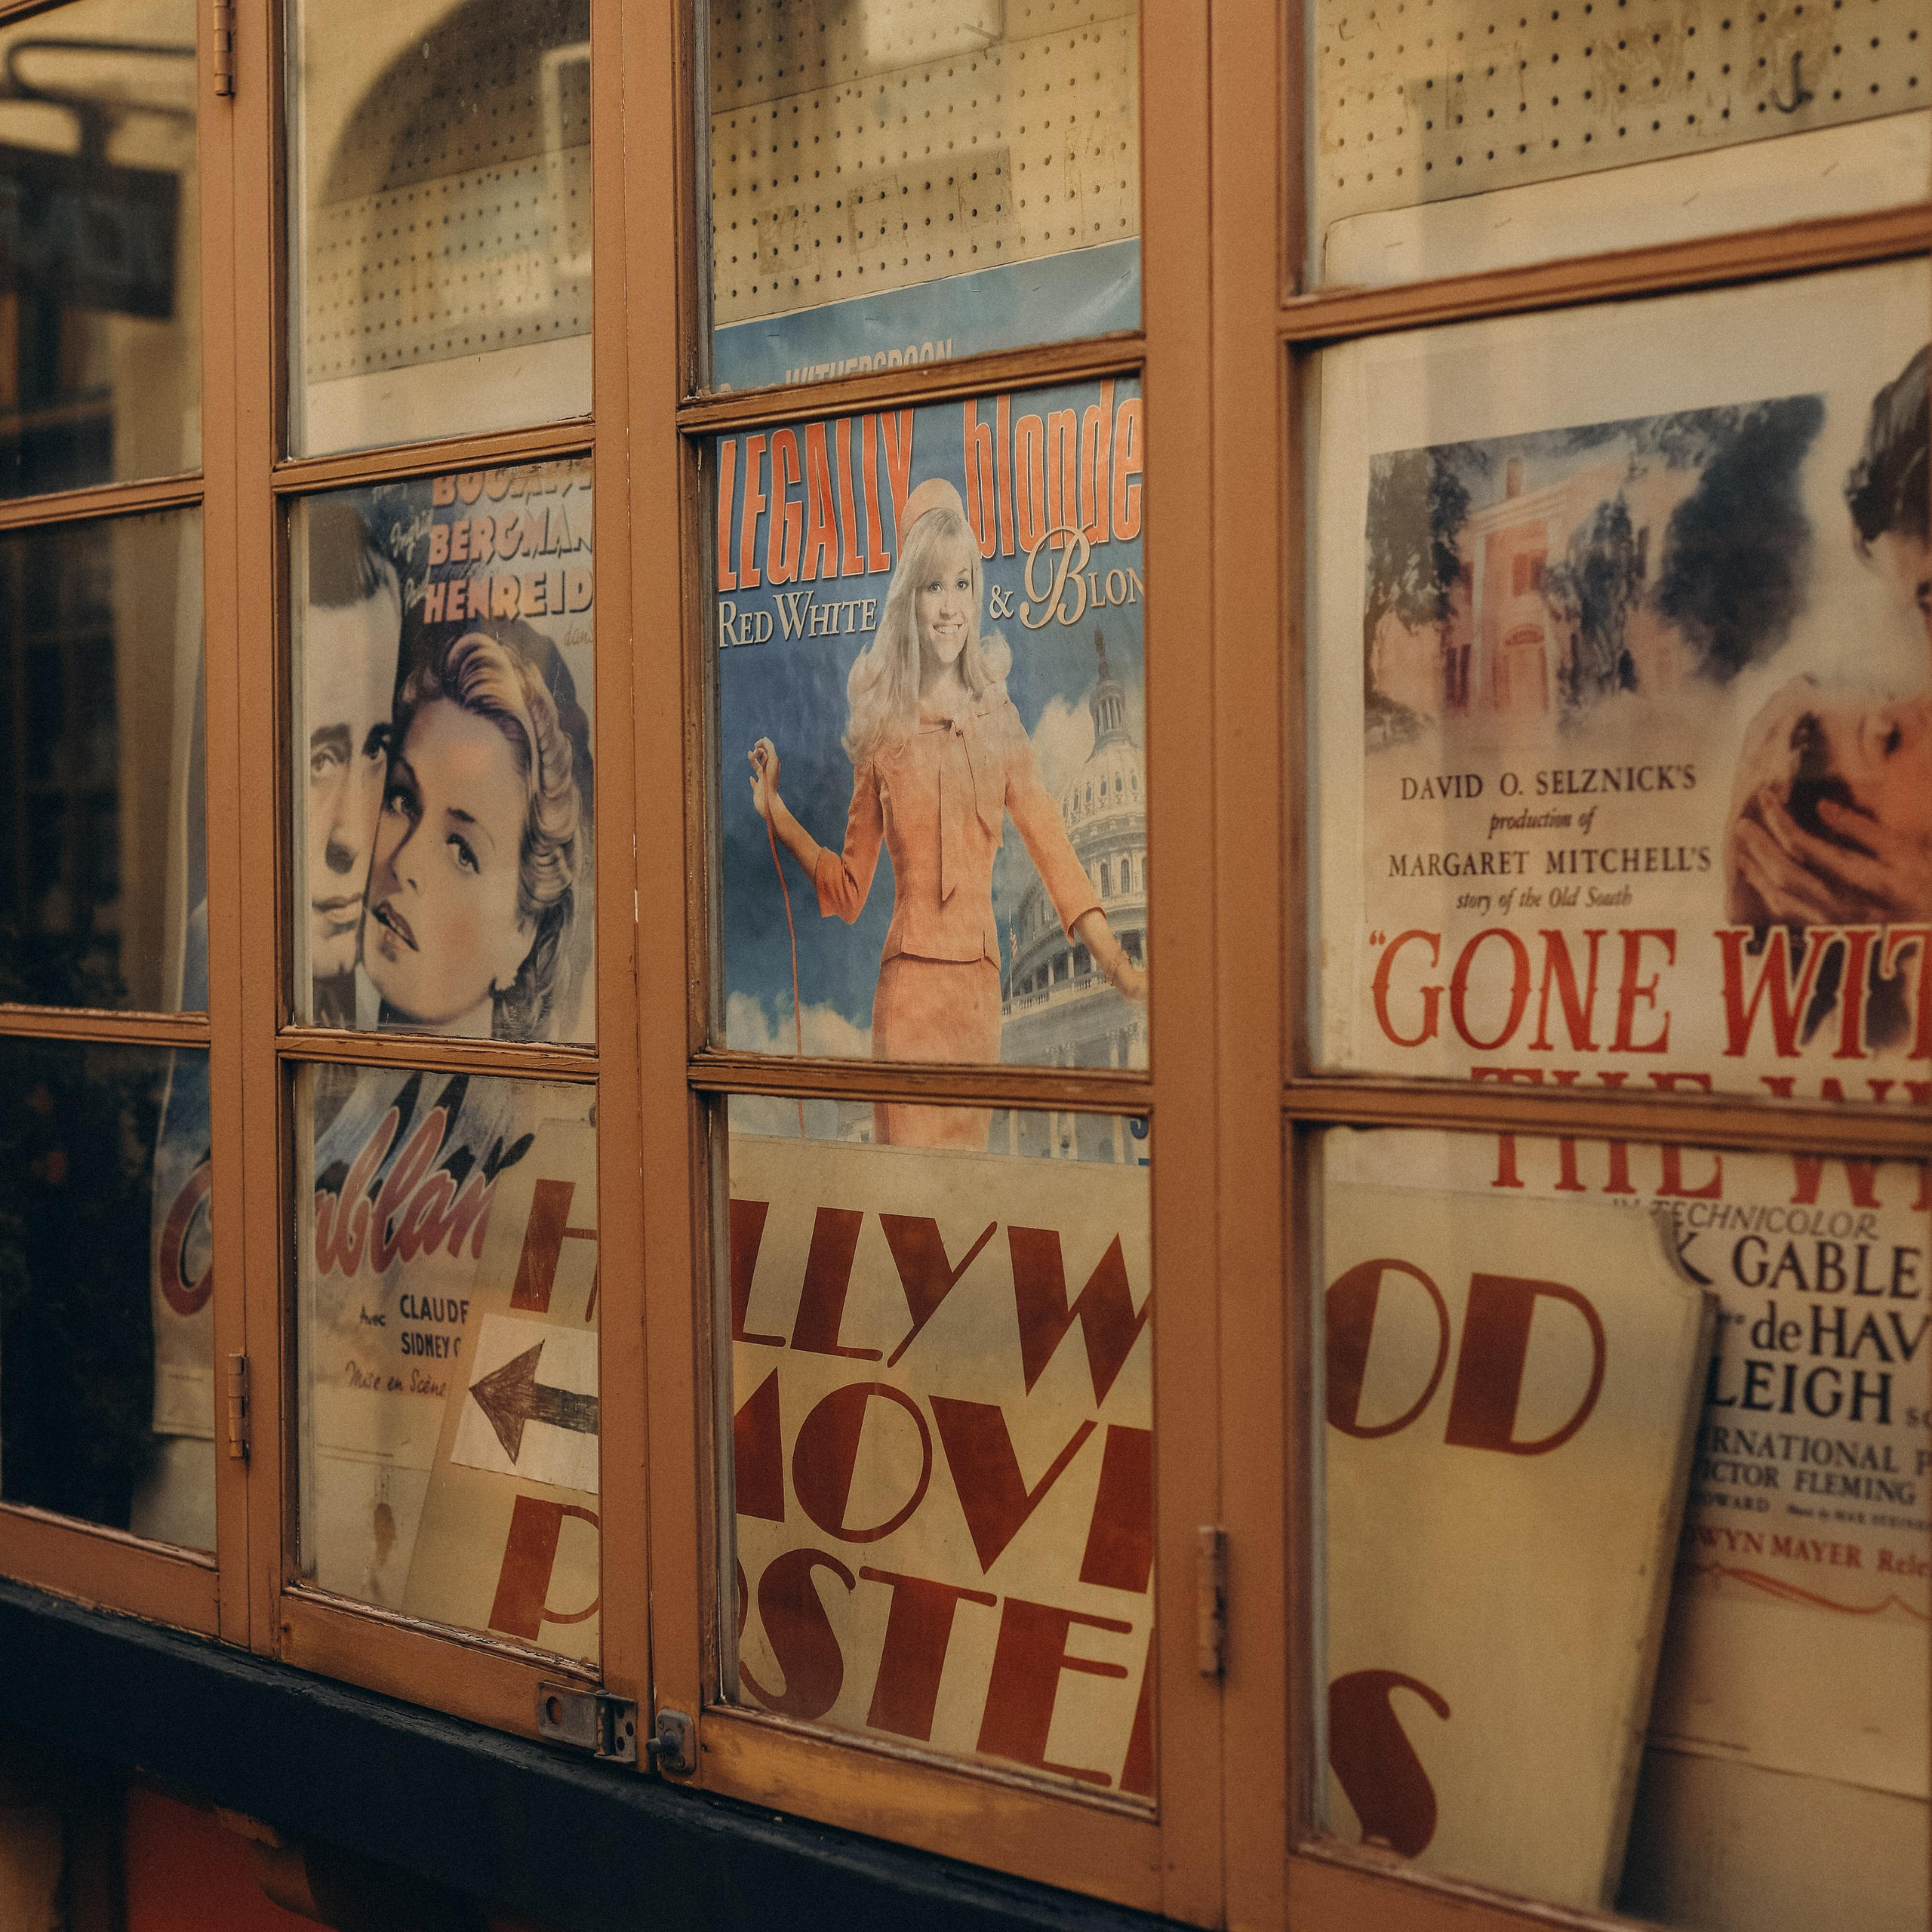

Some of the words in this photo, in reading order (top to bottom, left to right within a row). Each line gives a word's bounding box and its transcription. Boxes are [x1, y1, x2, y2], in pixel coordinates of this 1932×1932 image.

[718, 408, 915, 592] LEGALLY
[964, 378, 1143, 560] blonde
[428, 504, 592, 567] BERGMAN
[423, 568, 593, 626] HENREID
[989, 585, 1014, 620] &
[1020, 521, 1144, 630] BLON
[1401, 774, 1484, 801] DAVID
[1500, 771, 1524, 797] O.
[1536, 764, 1697, 795] SELZNICK'S
[1487, 808, 1572, 839] production
[1578, 805, 1598, 835] of
[1387, 851, 1531, 878] MARGARET
[1545, 845, 1712, 875] MITCHELL'S
[1456, 891, 1491, 917] story
[1498, 886, 1518, 915] of
[1519, 886, 1543, 908] the
[1549, 884, 1581, 907] Old
[1585, 884, 1633, 907] South
[1713, 925, 1932, 1059] WIT
[1731, 1235, 1923, 1300] GABLE
[401, 1331, 450, 1359] SIDNEY
[1808, 1303, 1932, 1364] HAV
[387, 1376, 404, 1392] en
[1707, 1358, 1894, 1426] LEIGH
[1794, 1468, 1916, 1506] FLEMING
[1770, 1534, 1863, 1569] MAYER
